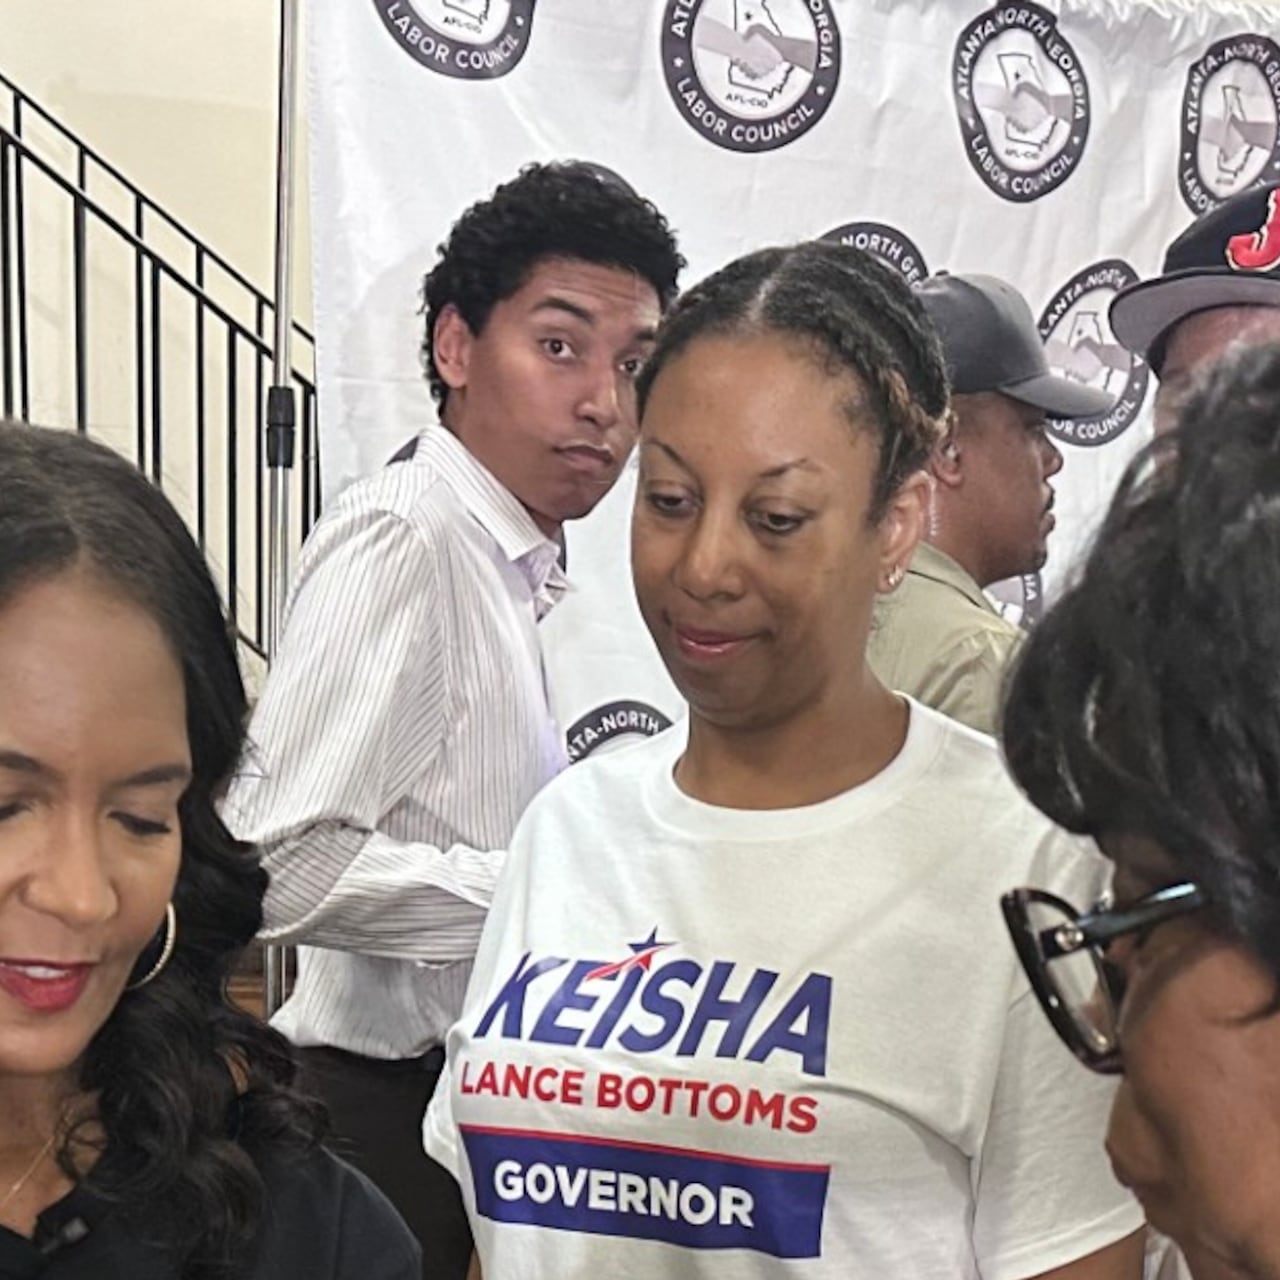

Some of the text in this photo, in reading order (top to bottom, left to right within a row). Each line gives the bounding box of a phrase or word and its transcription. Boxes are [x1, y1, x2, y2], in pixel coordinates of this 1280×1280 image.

[387, 2, 520, 70] LABOR COUNCIL
[809, 0, 833, 69] ORGIA
[677, 77, 815, 143] LABOR COUNCIL
[971, 134, 1009, 190] LABOR
[1076, 399, 1136, 439] COUNCIL
[472, 951, 833, 1077] KEISHA
[460, 1061, 819, 1135] LANCE BOTTOMS
[493, 1161, 755, 1229] GOVERNOR
